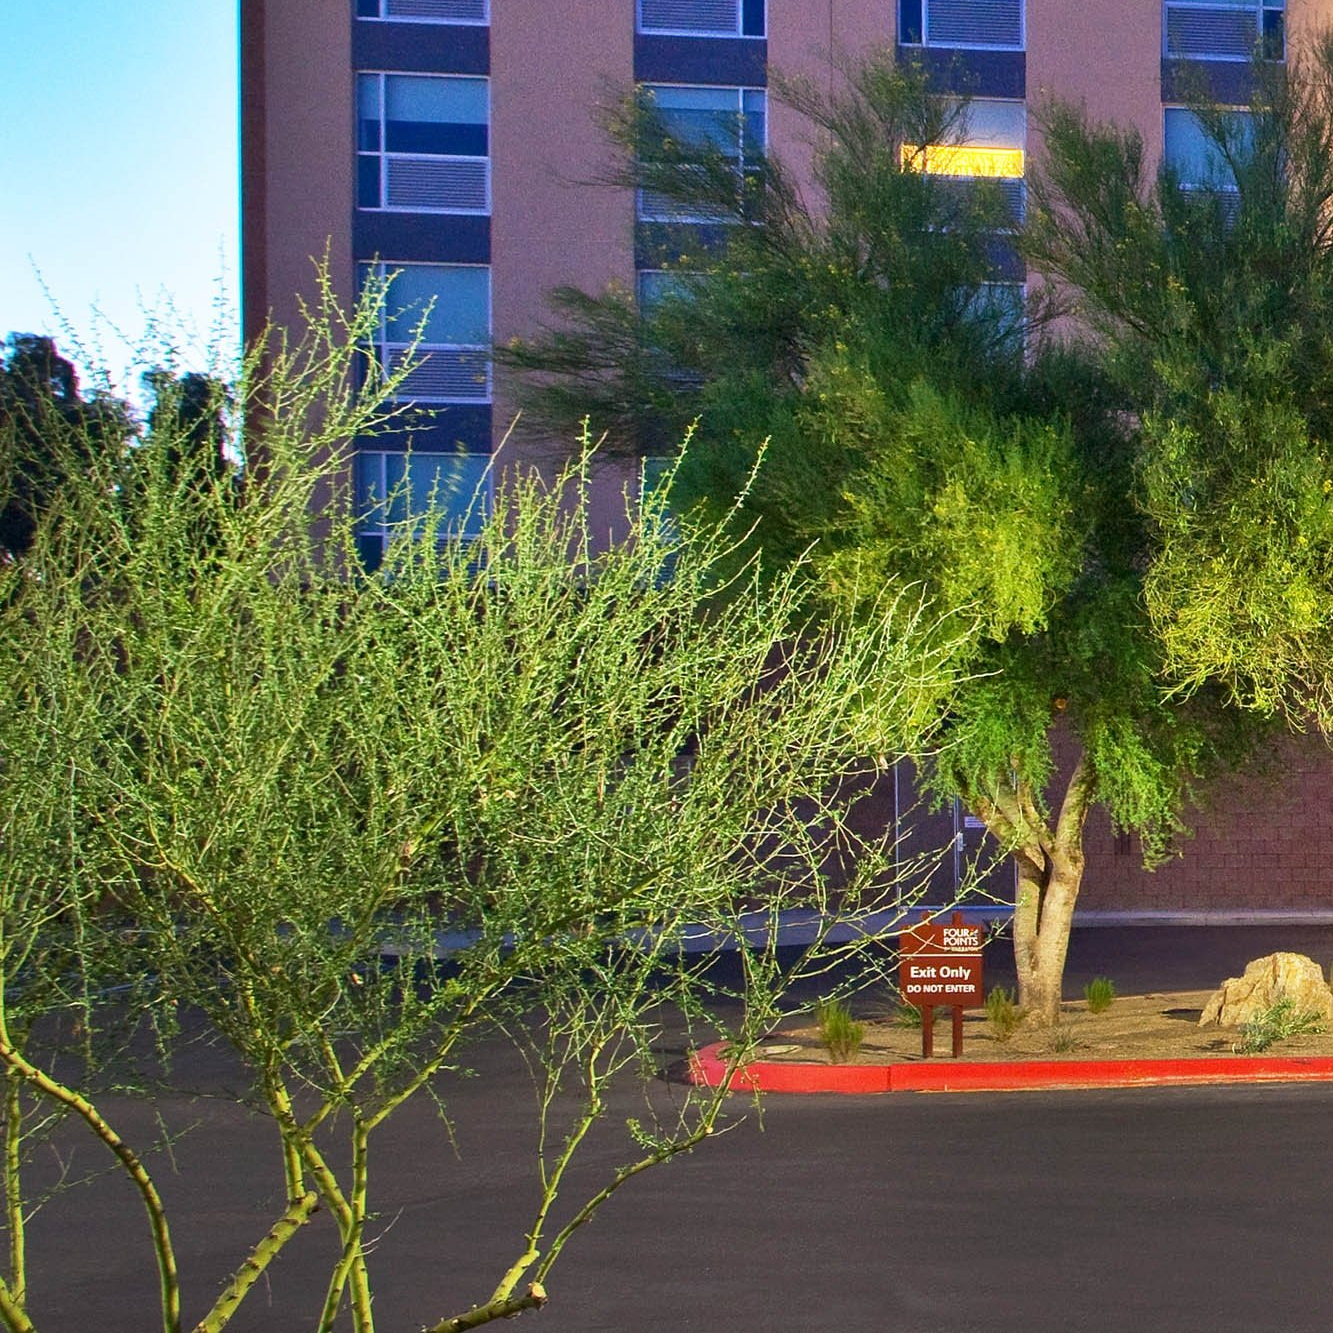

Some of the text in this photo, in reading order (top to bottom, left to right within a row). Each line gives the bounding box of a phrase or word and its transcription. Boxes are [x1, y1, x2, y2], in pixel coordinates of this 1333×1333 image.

[943, 928, 969, 937] FOUR
[943, 937, 979, 946] POINTS
[910, 966, 972, 981] Exit Only
[907, 984, 976, 994] DO NOT ENTER
